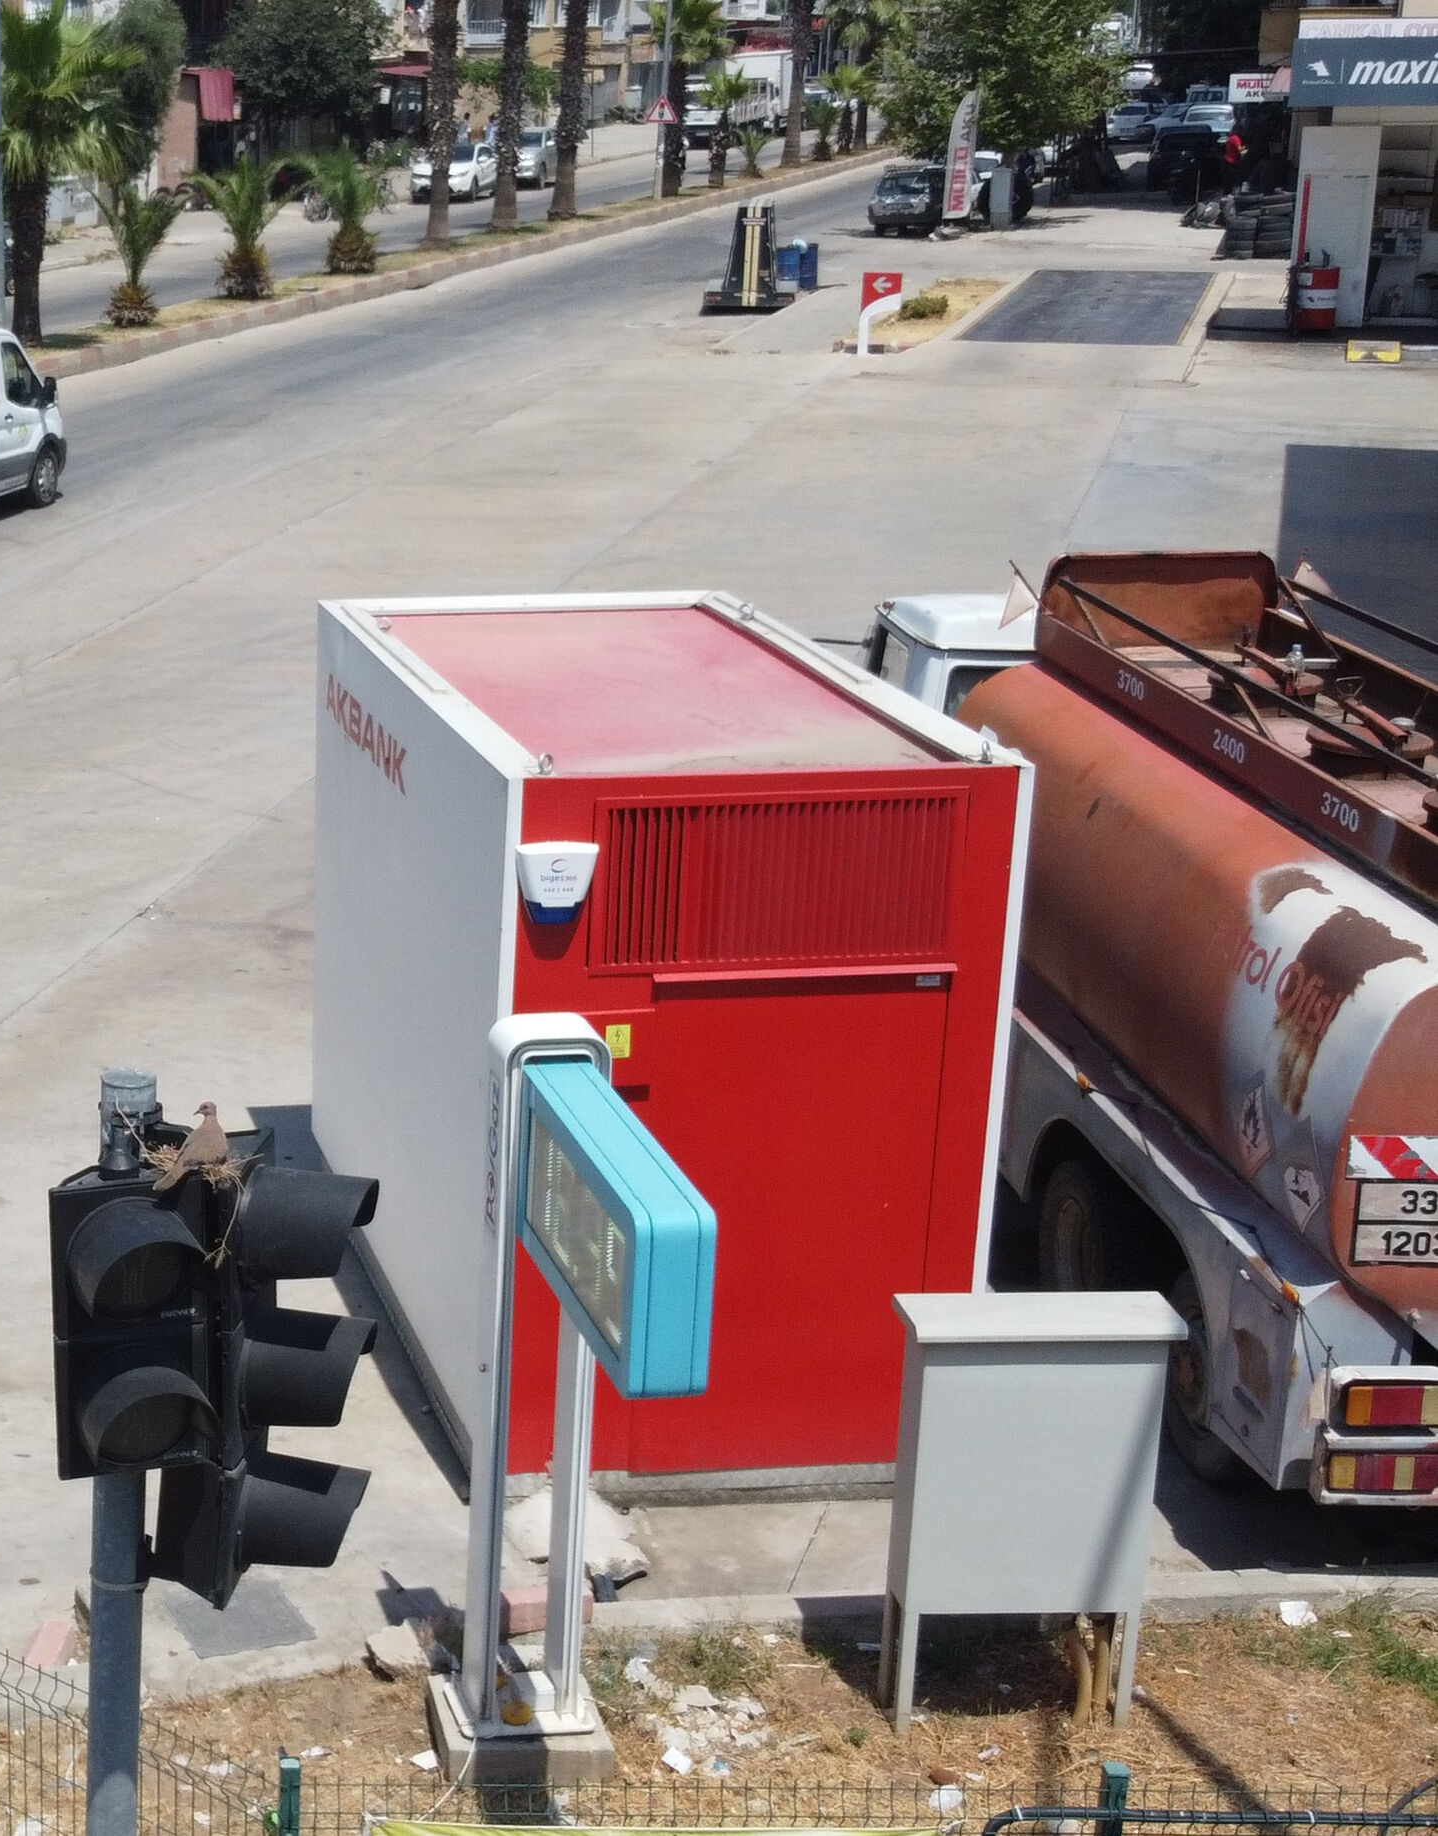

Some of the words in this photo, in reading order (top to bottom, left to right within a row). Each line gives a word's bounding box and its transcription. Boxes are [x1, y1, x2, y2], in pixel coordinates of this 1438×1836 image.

[1236, 78, 1272, 90] MUTL
[1117, 669, 1145, 701] 3700
[326, 672, 407, 796] AKBANK
[1213, 728, 1245, 764] 2400
[1321, 792, 1360, 833] 3700
[1400, 1190, 1438, 1215] 33
